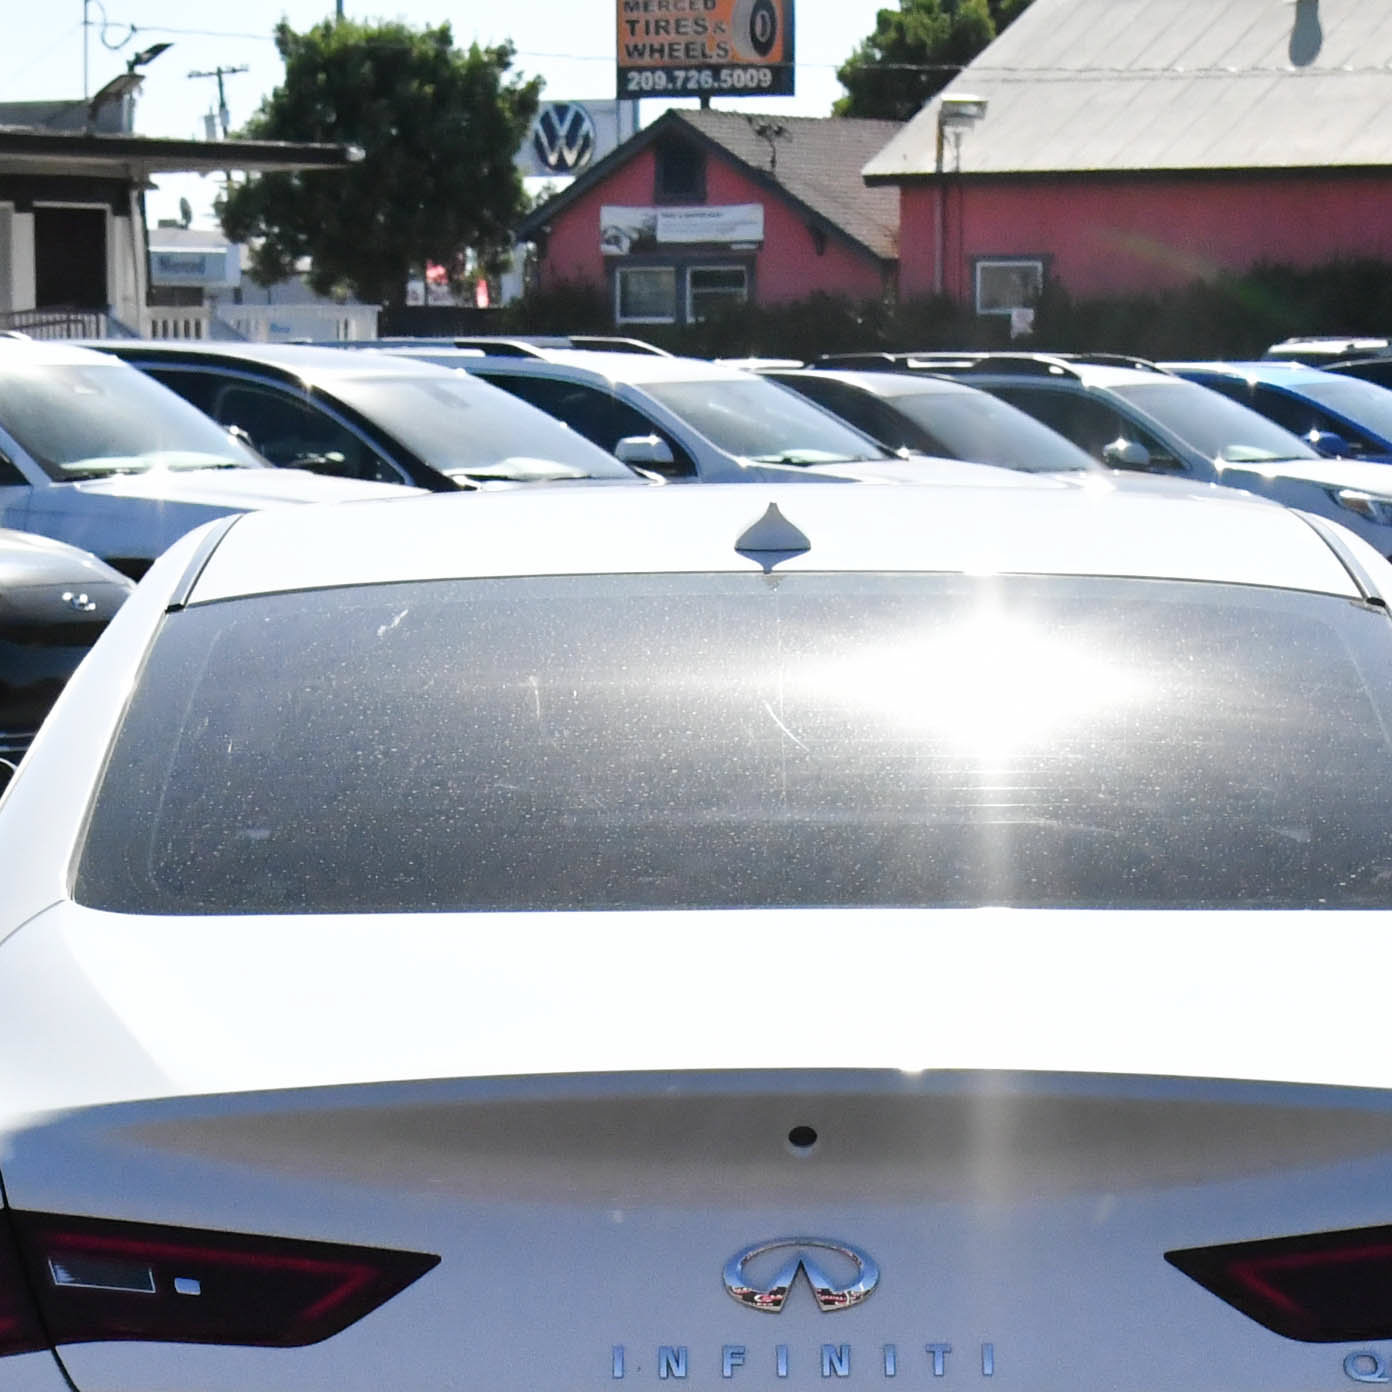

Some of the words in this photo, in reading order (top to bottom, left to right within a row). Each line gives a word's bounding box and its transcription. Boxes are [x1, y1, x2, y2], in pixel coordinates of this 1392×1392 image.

[624, 0, 716, 12] MERCED
[625, 18, 708, 36] TIRES
[624, 41, 729, 60] WHEELS
[627, 68, 772, 91] 209.726.5009
[611, 1343, 994, 1379] INFINITI
